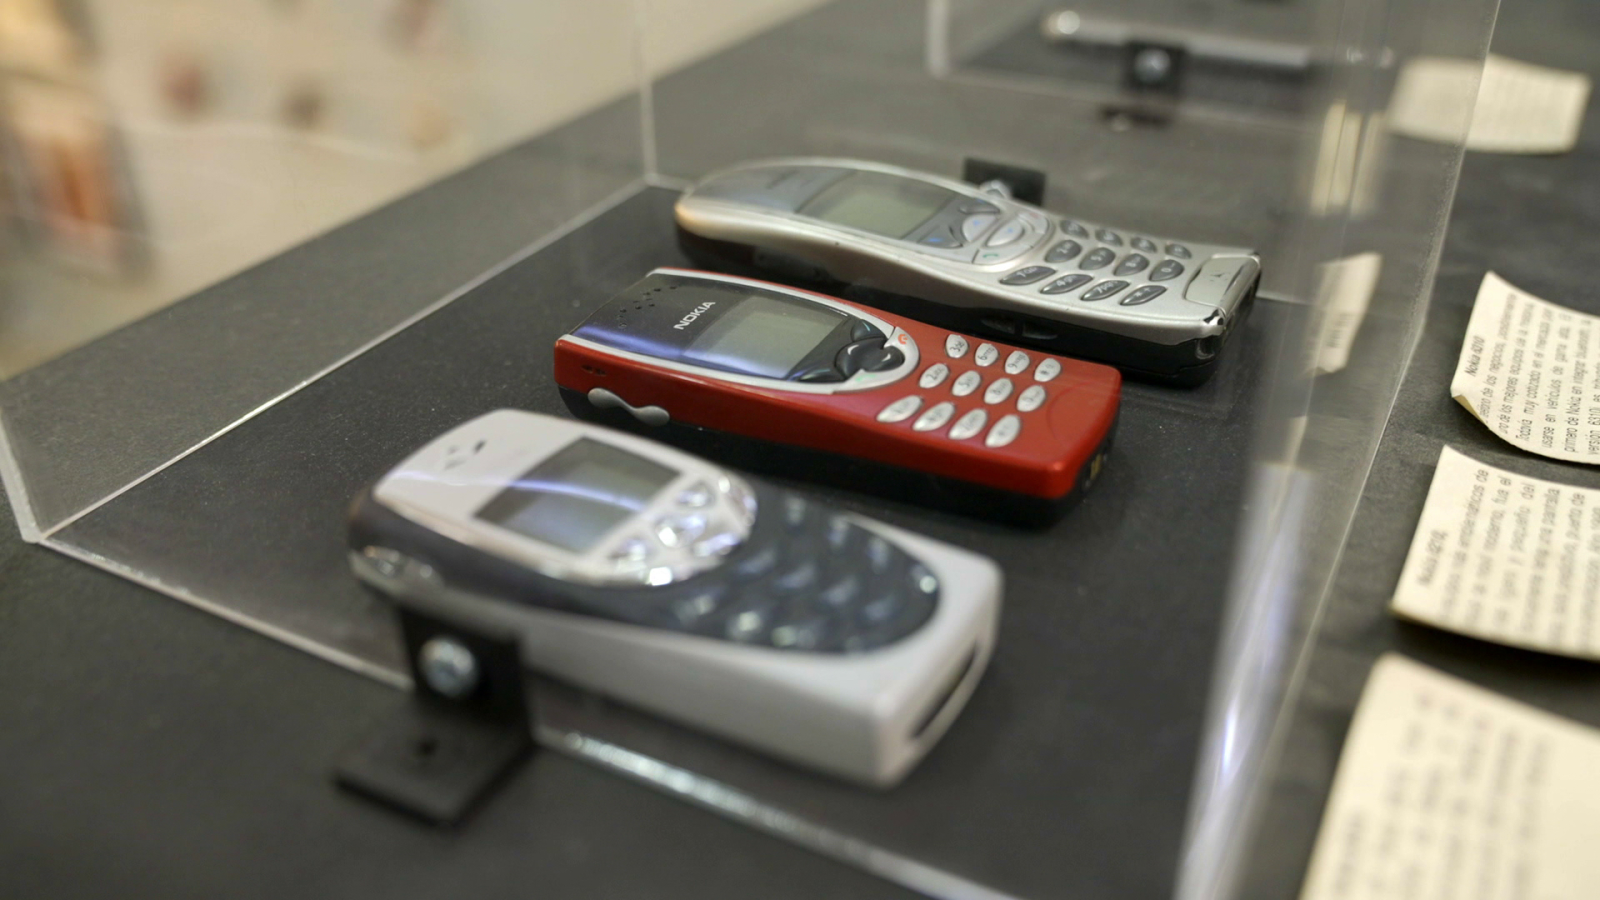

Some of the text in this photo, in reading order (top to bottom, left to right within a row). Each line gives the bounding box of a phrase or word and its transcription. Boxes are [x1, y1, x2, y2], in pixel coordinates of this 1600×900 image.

[673, 301, 716, 330] NOKIA
[1464, 354, 1481, 377] Nokia
[1509, 349, 1524, 376] equipos
[1532, 360, 1542, 369] en
[1549, 366, 1564, 375] de
[1482, 376, 1497, 387] los
[1571, 361, 1588, 385] integrar
[1481, 388, 1494, 398] de
[1502, 377, 1519, 404] mejores
[1525, 370, 1541, 399] cotizado
[1571, 386, 1582, 395] en
[1544, 379, 1561, 410] vehículos
[1498, 404, 1512, 414] los
[1523, 400, 1539, 415] muy
[1565, 396, 1582, 415] Nokia
[1497, 415, 1510, 423] de
[1544, 414, 1556, 423] en
[1563, 417, 1579, 426] de
[1515, 419, 1532, 442] Todavía
[1541, 426, 1555, 448] usarse
[1561, 427, 1579, 453] primero
[1585, 430, 1600, 455] versión
[1473, 469, 1489, 483] de
[1497, 476, 1511, 486] el
[1520, 483, 1535, 500] del
[1567, 492, 1586, 506] de
[1540, 488, 1560, 526] pantalla
